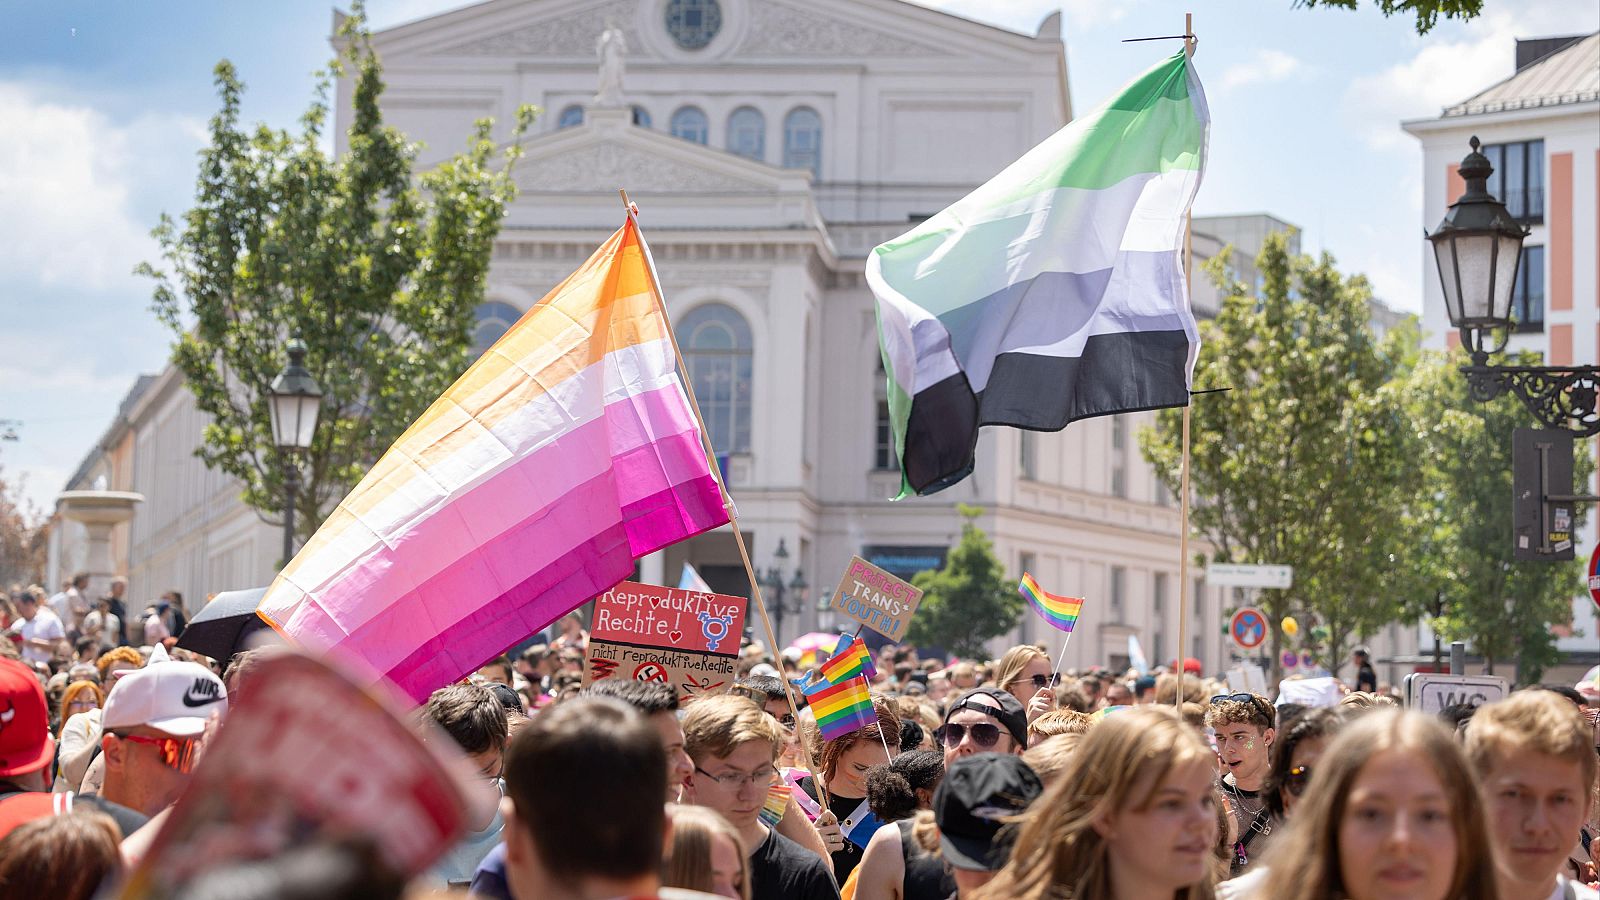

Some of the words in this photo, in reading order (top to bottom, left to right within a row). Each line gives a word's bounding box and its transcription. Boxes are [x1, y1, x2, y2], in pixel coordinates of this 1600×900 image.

[850, 562, 916, 603] PROTECT
[840, 591, 900, 635] YOUTH!
[592, 644, 618, 660] nicht
